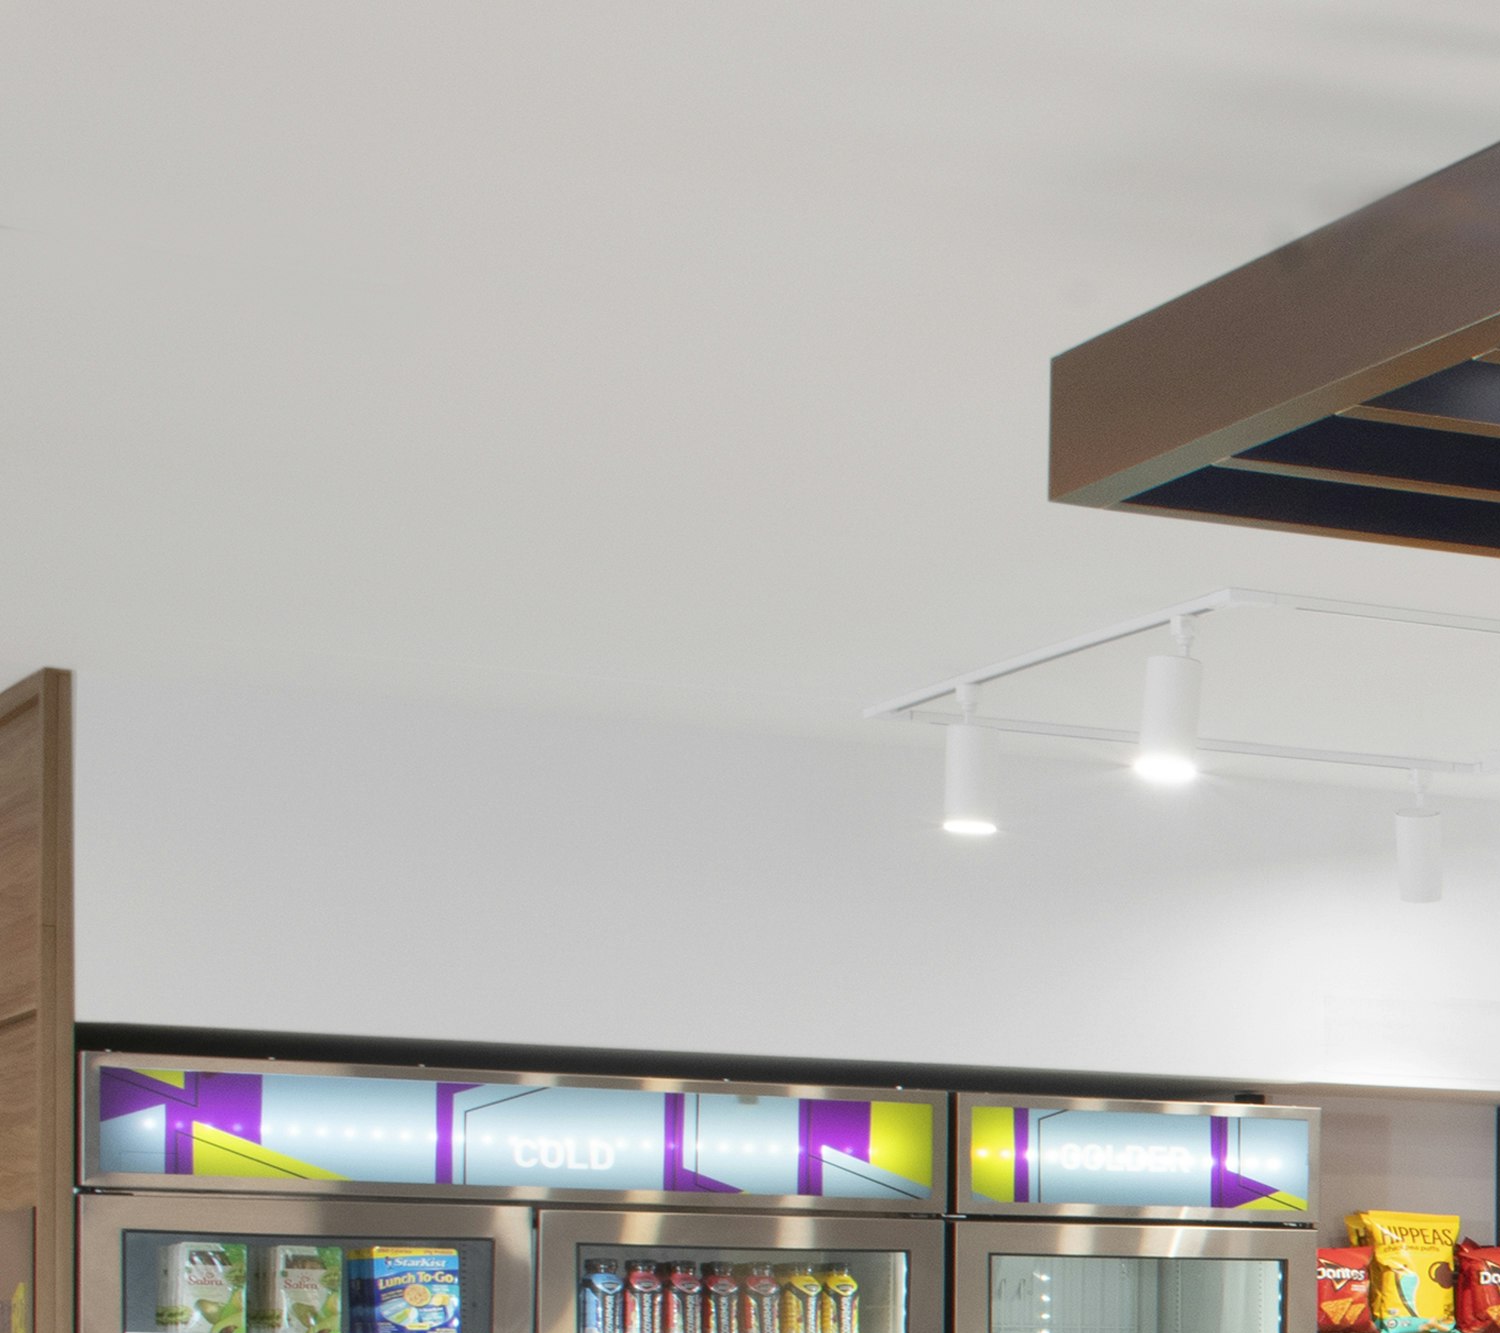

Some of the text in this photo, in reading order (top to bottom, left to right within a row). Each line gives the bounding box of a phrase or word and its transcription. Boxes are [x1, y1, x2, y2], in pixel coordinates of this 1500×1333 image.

[513, 1136, 615, 1171] COLD
[1060, 1143, 1191, 1173] COLDER
[1381, 1225, 1454, 1247] HIPPEAS
